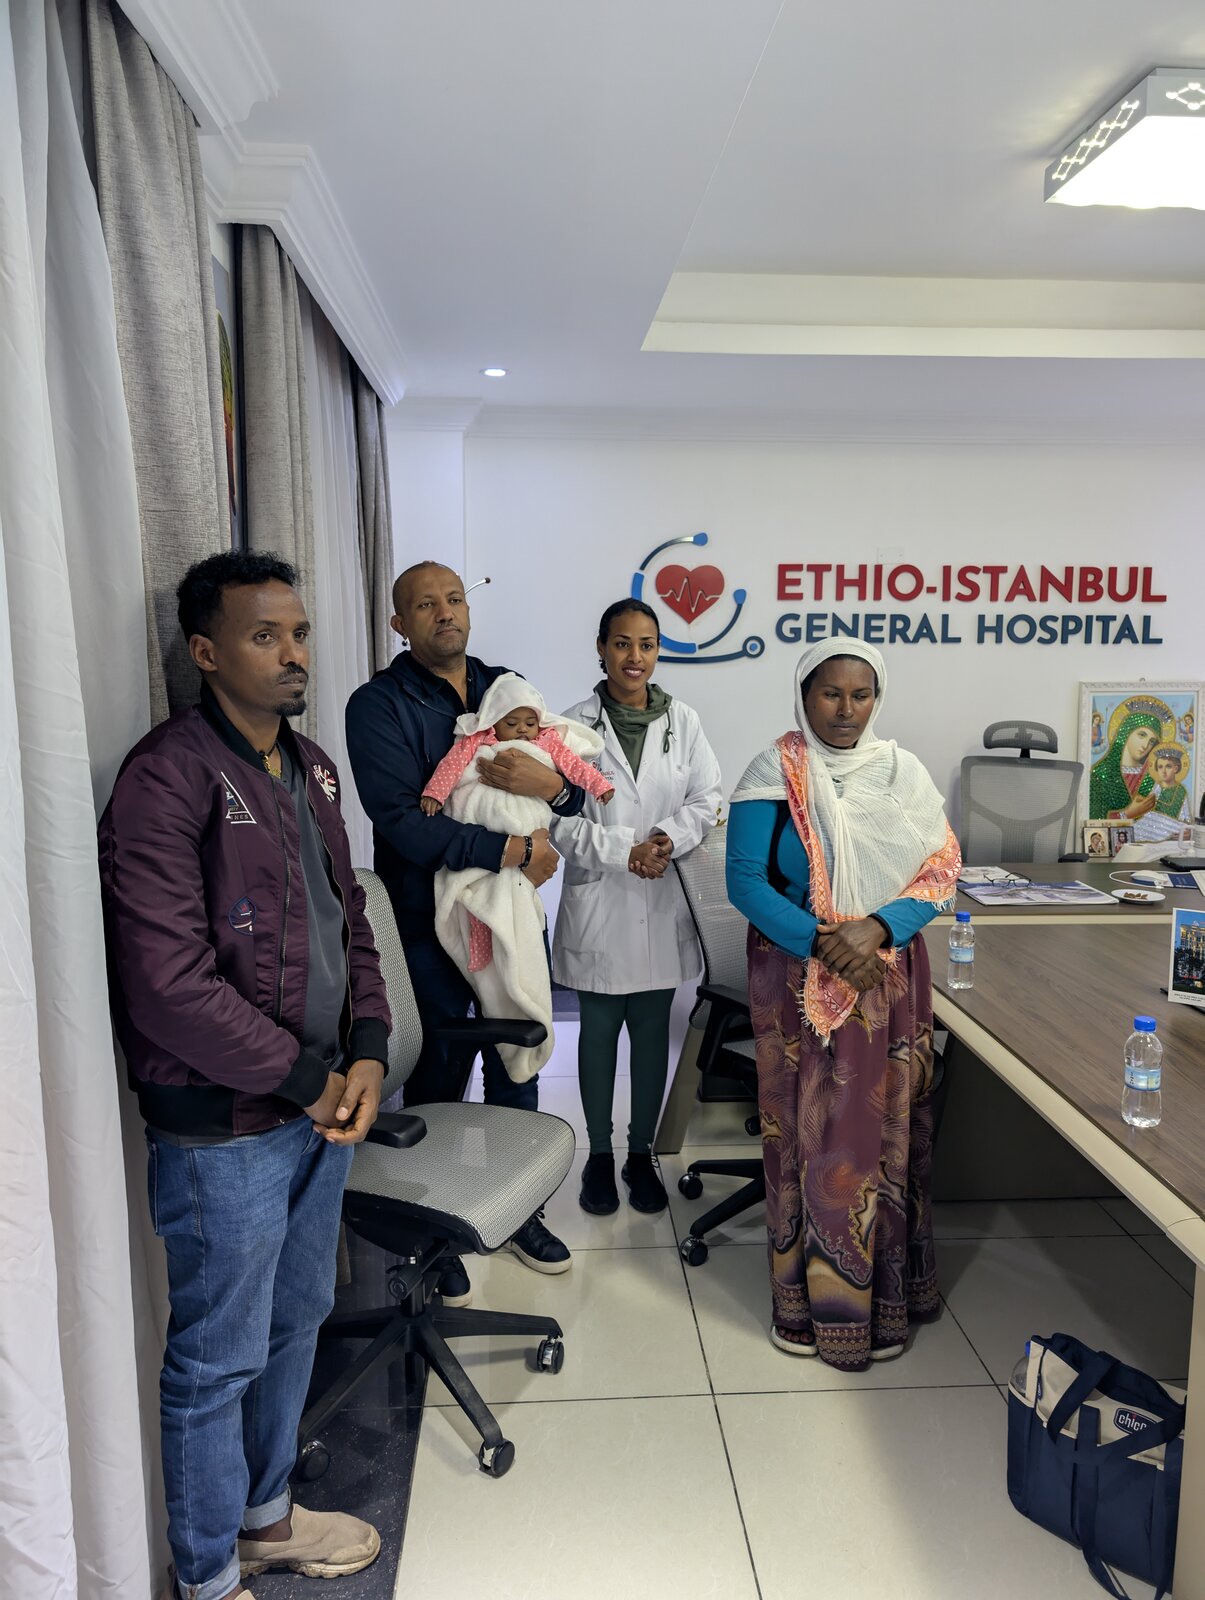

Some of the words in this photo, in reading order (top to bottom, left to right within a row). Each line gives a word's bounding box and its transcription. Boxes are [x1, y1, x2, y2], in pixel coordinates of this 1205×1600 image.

[777, 563, 1167, 603] ETHIO-ISTANBUL
[775, 612, 962, 644] GENERAL
[977, 614, 1163, 644] HOSPITAL
